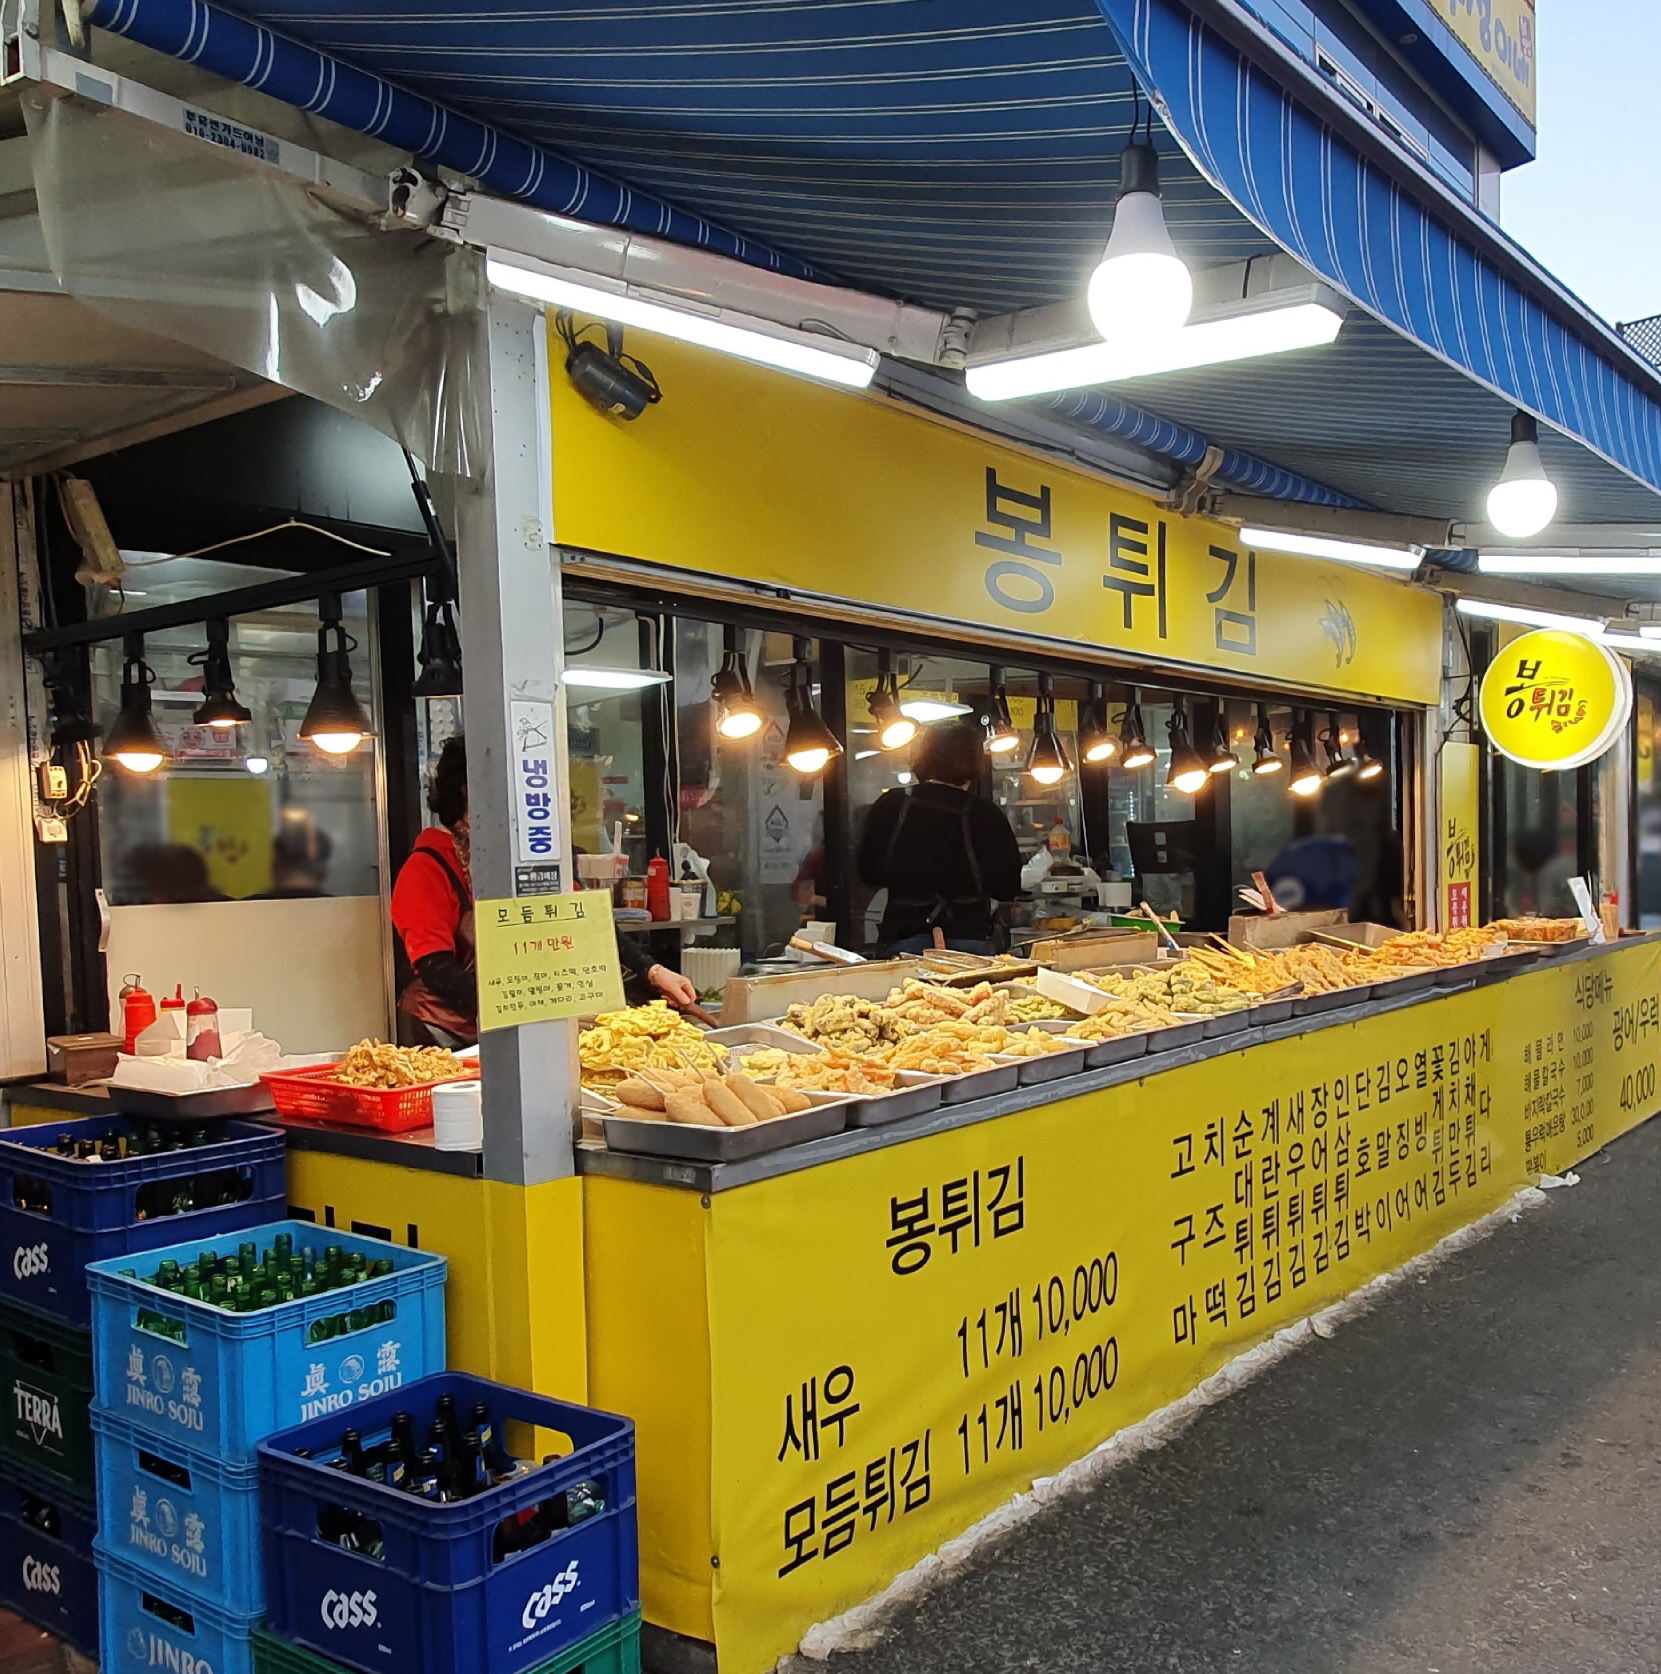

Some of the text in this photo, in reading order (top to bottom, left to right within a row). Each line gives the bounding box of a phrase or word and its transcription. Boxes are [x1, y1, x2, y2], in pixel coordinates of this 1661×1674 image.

[522, 759, 552, 854] 냉방중
[514, 935, 575, 955] 11개 만원
[1395, 1057, 1411, 1222] 오징어
[1414, 1049, 1429, 1211] 열빙어
[1431, 1044, 1446, 1206] 꽃게튀김
[1449, 1037, 1462, 1197] 김치만두
[1464, 1032, 1478, 1188] 야채튀김
[1480, 1027, 1492, 1175] 게다리
[1573, 1047, 1594, 1072] 10,000
[1576, 1072, 1594, 1097] 7,000
[1576, 1123, 1595, 1149] 5,000
[1619, 1062, 1656, 1113] 40,000
[885, 1155, 1025, 1276] 봉튀김
[1203, 1117, 1228, 1328] 치즈떡
[1232, 1110, 1255, 1319] 순대튀김
[1261, 1098, 1282, 1303] 계란튀김
[1286, 1089, 1307, 1289] 새우튀김
[1311, 1082, 1329, 1275] 장어튀김
[1333, 1074, 1351, 1261] 인삼튀김
[1355, 1067, 1372, 1243] 단호박
[1376, 1060, 1392, 1232] 김말이
[1170, 1133, 1197, 1346] 고구마
[13, 1387, 64, 1439] TERRA
[126, 1383, 204, 1431] JINRO SOJU
[300, 1372, 402, 1424] JINRO SOJU
[777, 1250, 1118, 1463] 새우 11개 10,000
[778, 1336, 1119, 1580] 모듬튀김 11개 10,000
[130, 1523, 207, 1577] JINRO SOJU
